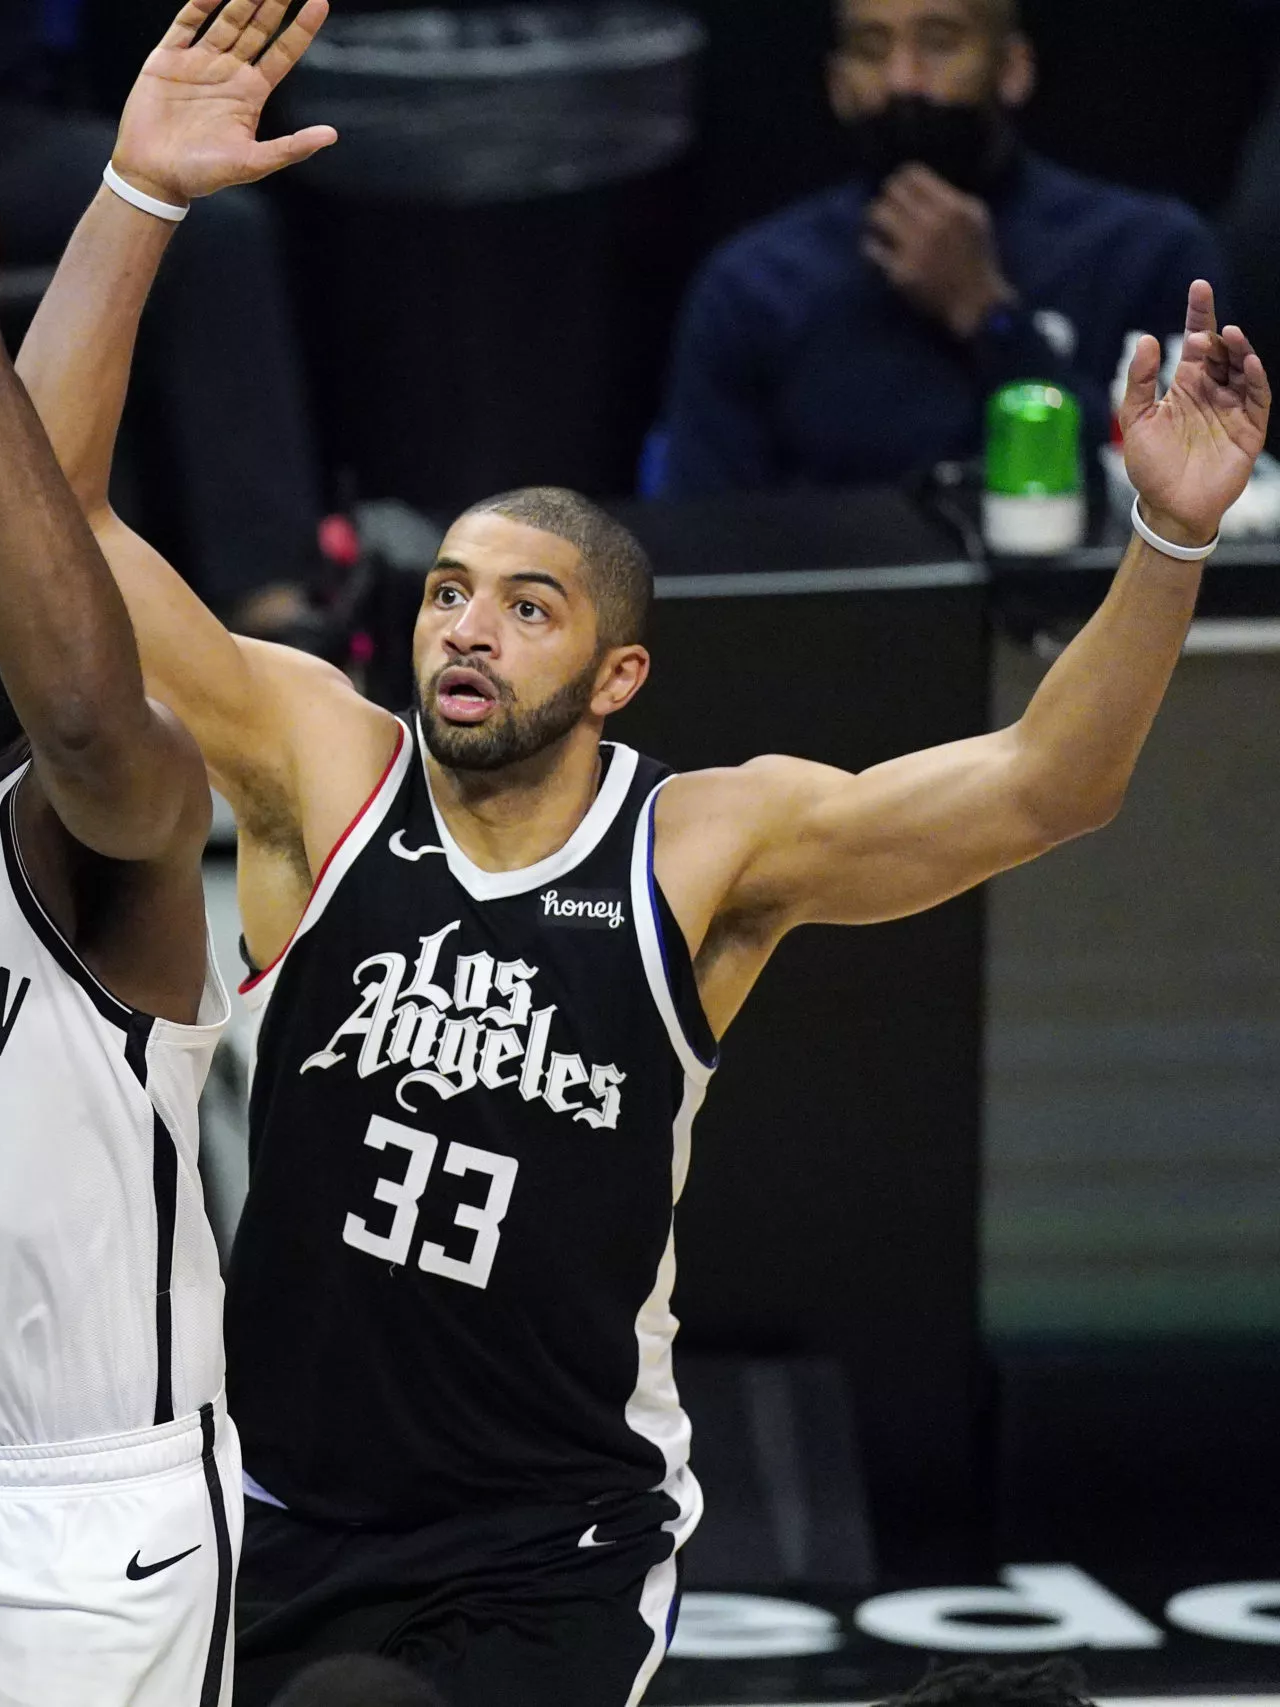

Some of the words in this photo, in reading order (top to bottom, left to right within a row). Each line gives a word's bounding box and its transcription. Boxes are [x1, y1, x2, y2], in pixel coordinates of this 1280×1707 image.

[397, 920, 539, 1026] Los
[540, 890, 625, 928] honey
[300, 951, 627, 1130] Angeles
[342, 1114, 519, 1290] 33
